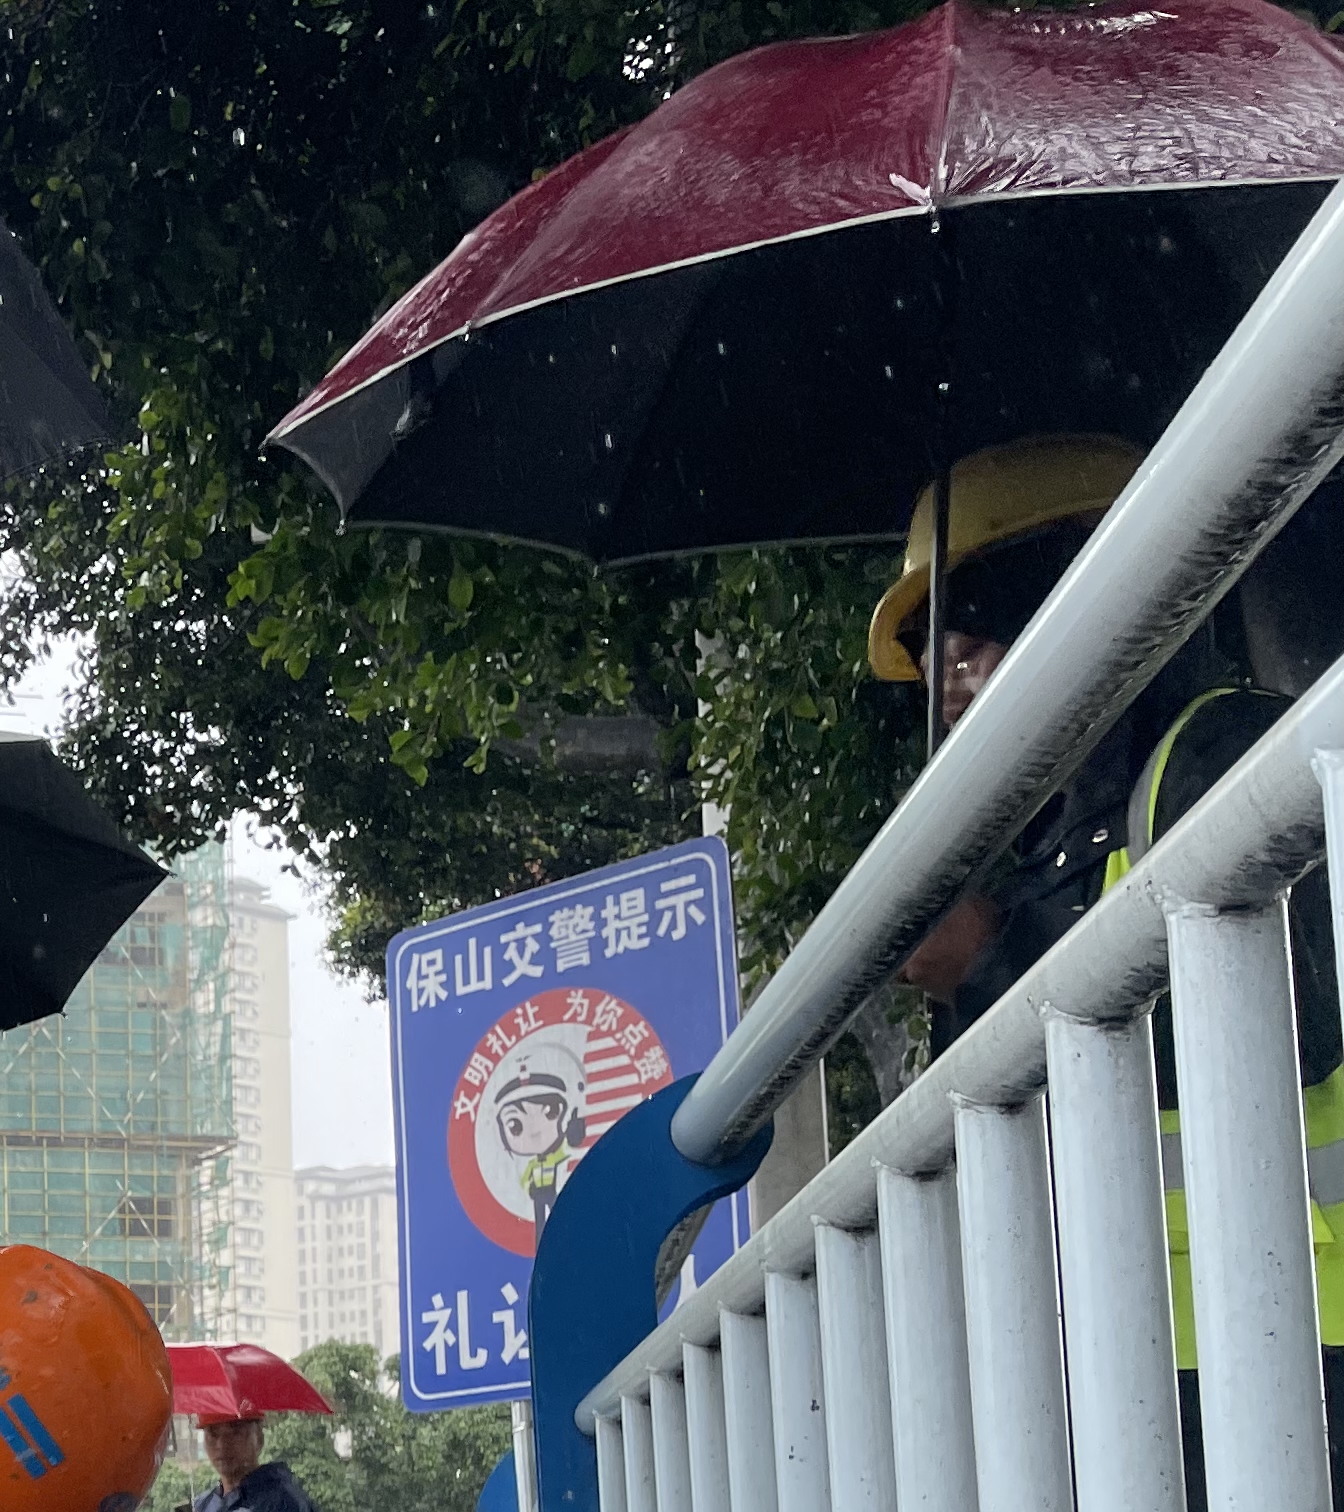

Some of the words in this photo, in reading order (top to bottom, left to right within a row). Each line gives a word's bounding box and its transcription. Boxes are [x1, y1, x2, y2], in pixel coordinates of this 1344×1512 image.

[406, 874, 707, 1012] 保山交警提示
[454, 1001, 544, 1122] 文明礼让
[563, 989, 668, 1085] 为你点赞
